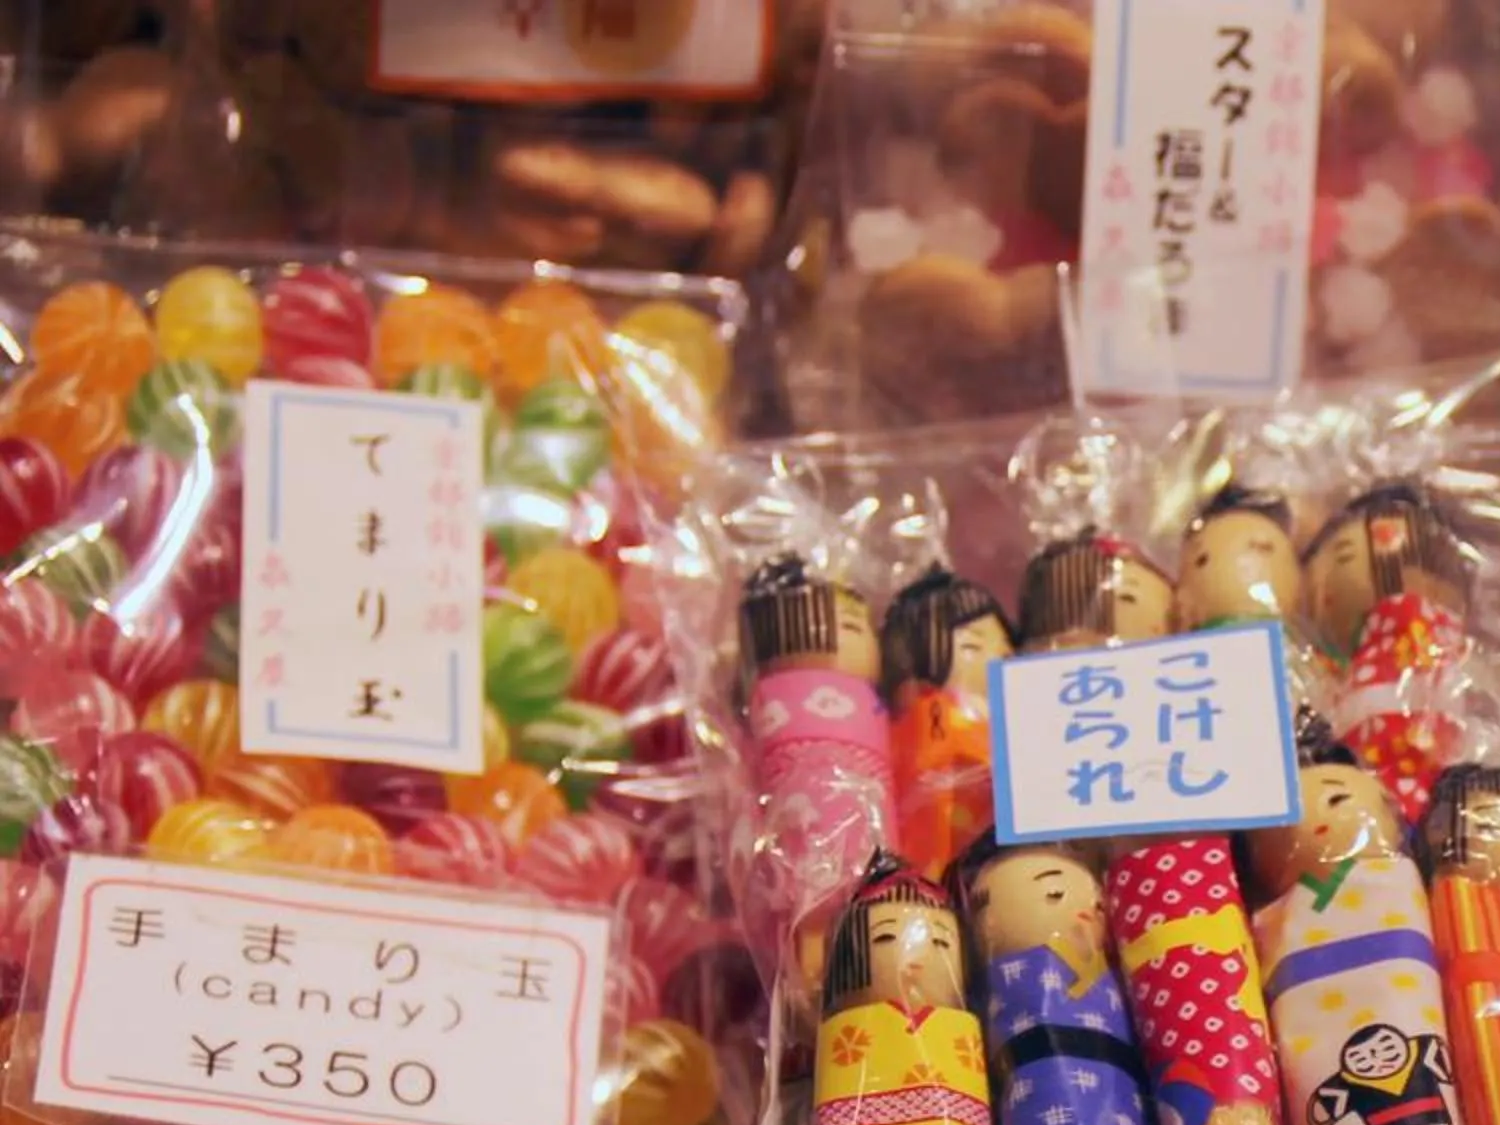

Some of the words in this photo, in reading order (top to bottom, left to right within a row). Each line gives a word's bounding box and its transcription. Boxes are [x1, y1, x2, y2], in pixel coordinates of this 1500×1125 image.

[348, 433, 403, 722] てまり玉
[1058, 665, 1136, 806] あられ
[1155, 651, 1229, 797] こけし
